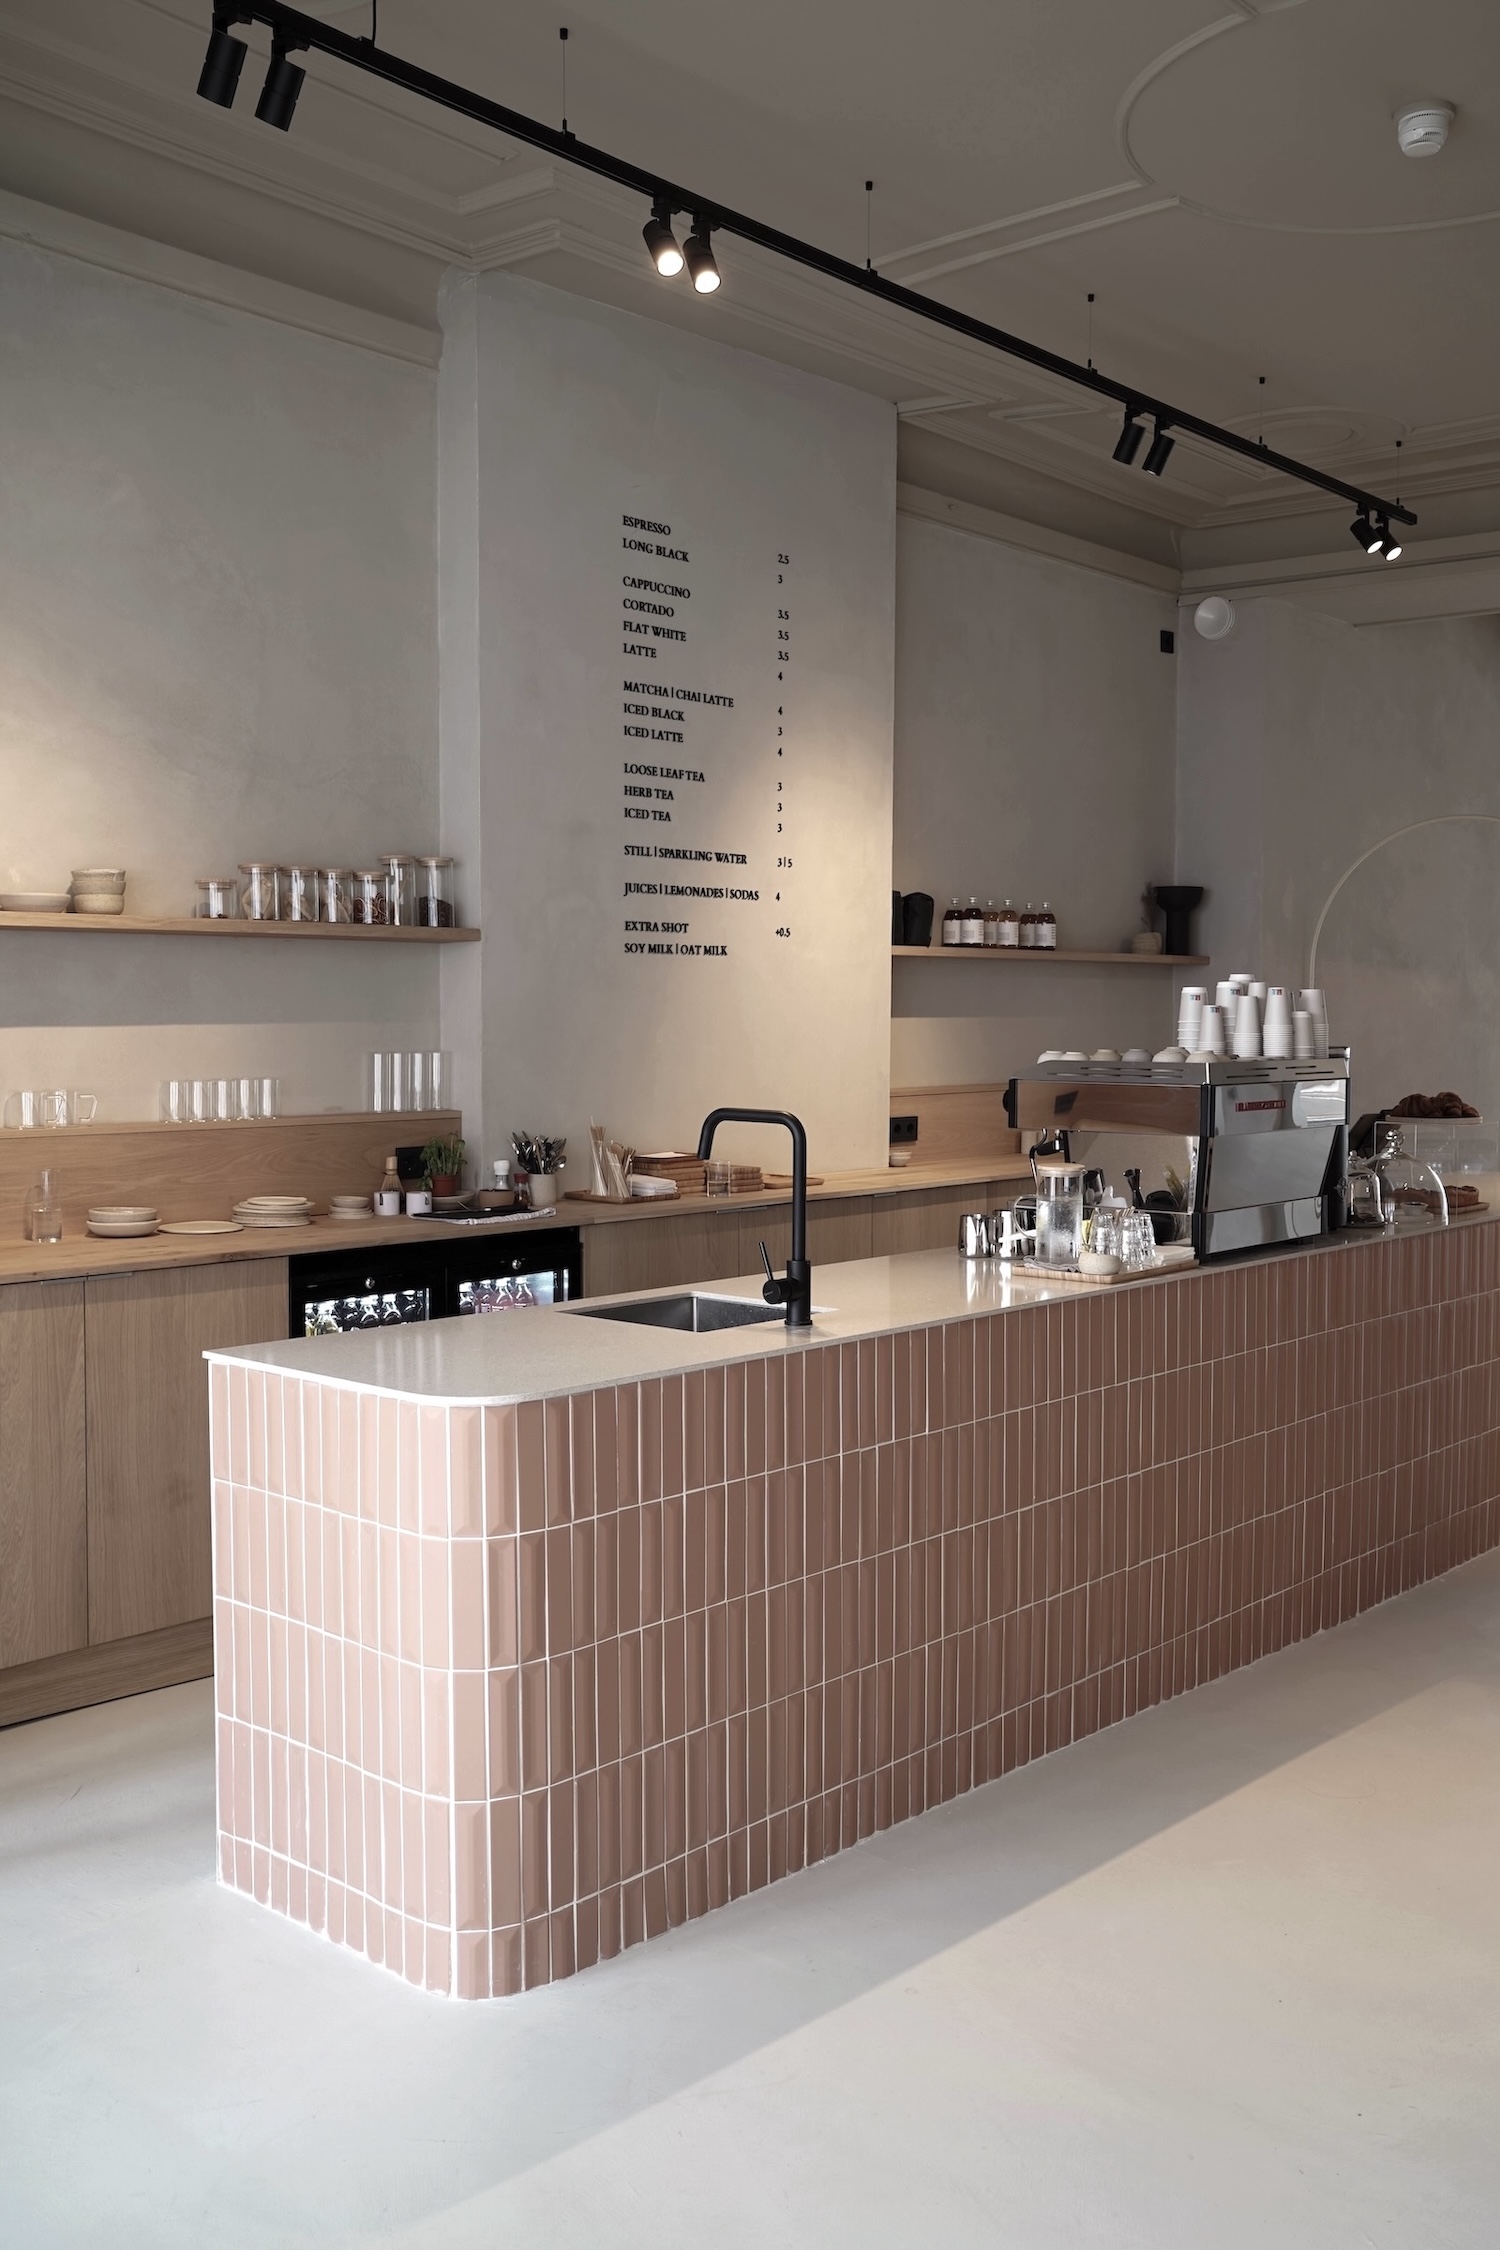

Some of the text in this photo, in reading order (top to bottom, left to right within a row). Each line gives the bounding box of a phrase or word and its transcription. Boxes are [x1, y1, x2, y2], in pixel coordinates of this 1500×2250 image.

[623, 515, 671, 535] ESPRESSO
[623, 538, 783, 584] LONG BLACK 3
[623, 576, 789, 620] CAPPUCCINO 3.5
[623, 599, 789, 640] CORTADO 3.5
[623, 621, 789, 661] FLAT WHITE 3.5
[623, 643, 783, 681] LATTE 4
[624, 681, 669, 697] MATCHA
[676, 689, 701, 702] CHAI
[703, 693, 734, 707] LATTE
[777, 706, 783, 715] 4
[624, 703, 783, 736] ICED BLACK 3
[624, 726, 783, 757] ICED LATTE 4
[624, 763, 783, 791] LOOSE LEAF TEA 3
[624, 785, 783, 812] HERB TEA 3
[624, 808, 783, 832] ICED TEA 3
[624, 845, 652, 857] STILL
[659, 848, 712, 861] SPARKLING
[714, 853, 747, 864] WATER
[623, 883, 658, 896] JUICES
[664, 885, 724, 898] LEMONADES
[730, 889, 759, 901] SODAS
[775, 892, 781, 901] 4
[625, 921, 790, 937] EXTRA SHOT +0.5
[624, 943, 645, 953] SOY
[648, 944, 673, 954] MILK
[680, 945, 702, 955] OAT
[703, 946, 727, 956] MILK
